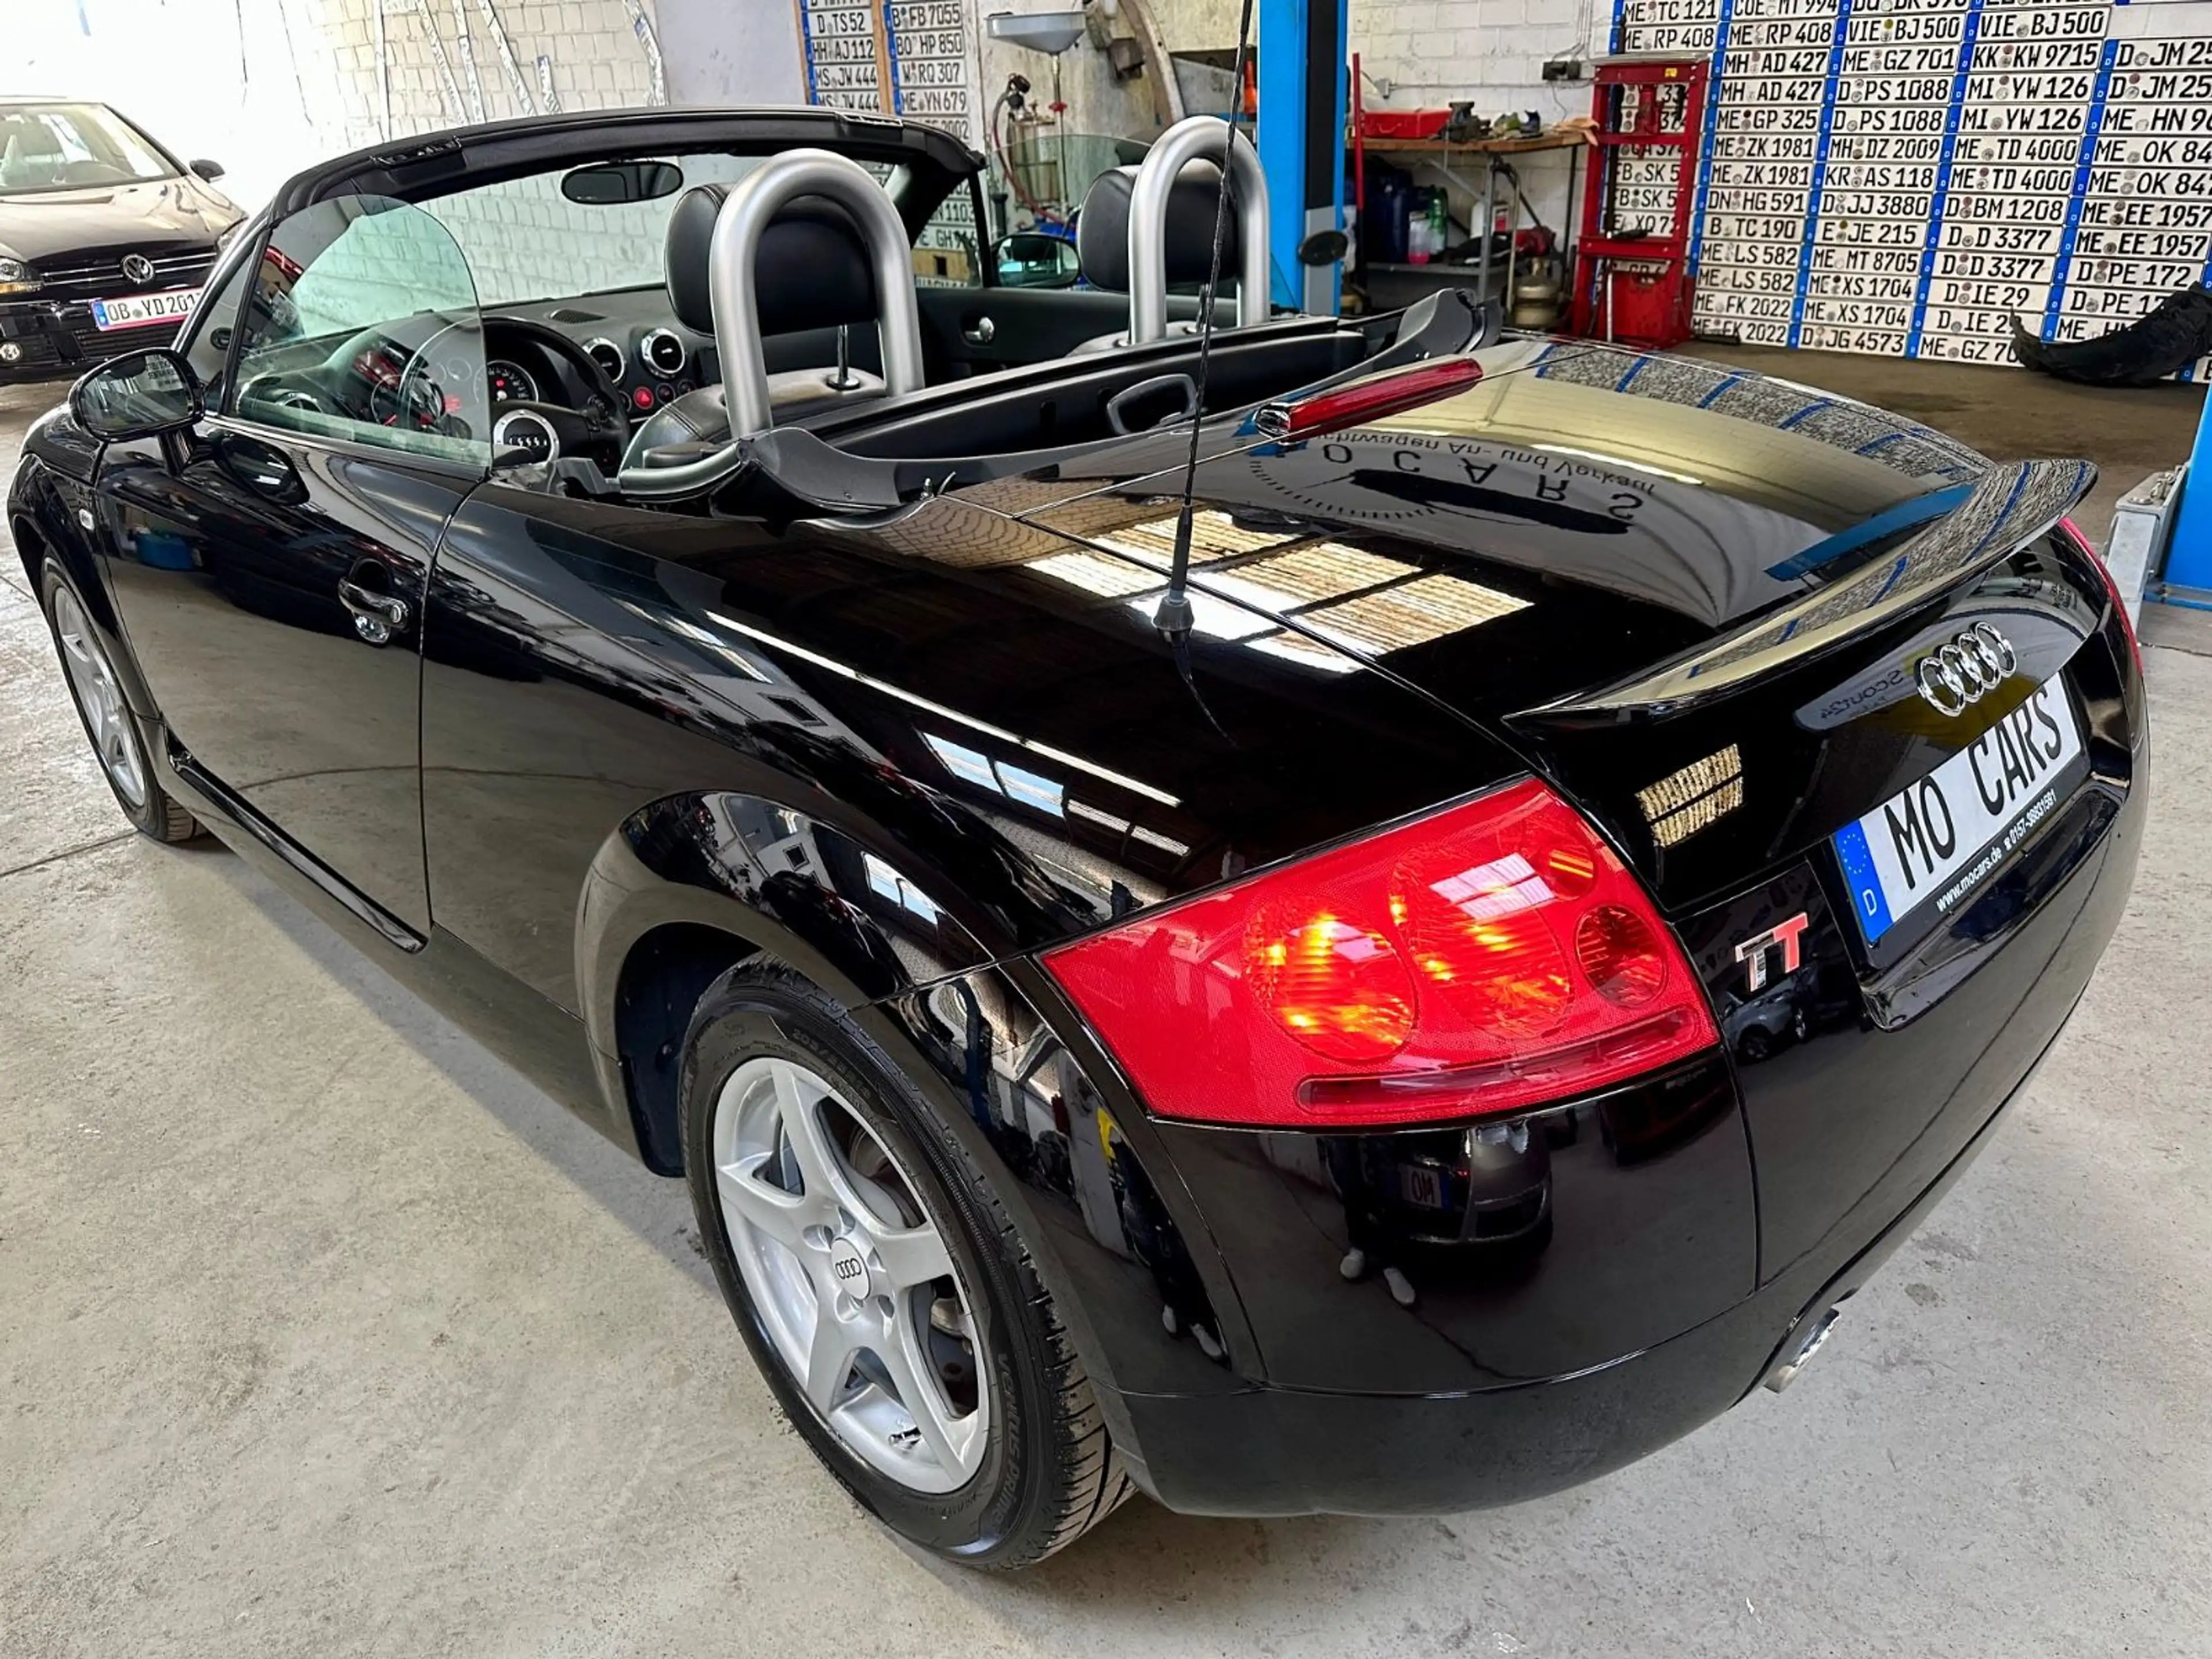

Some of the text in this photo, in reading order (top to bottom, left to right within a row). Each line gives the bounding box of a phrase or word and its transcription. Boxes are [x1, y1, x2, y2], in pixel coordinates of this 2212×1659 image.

[929, 4, 960, 24] 7055
[1659, 2, 1679, 21] TC
[1684, 0, 1715, 19] 121
[817, 12, 865, 33] D TS 52
[1729, 22, 1832, 46] ME RP 408
[1850, 17, 1960, 41] VIE BJ 500
[1981, 11, 2104, 37] VIE BJ 500
[940, 33, 962, 53] 850
[1724, 51, 1827, 74] MH AD 427
[1843, 48, 1954, 71] ME GZ 701
[1973, 43, 2098, 68] KK KW 9715
[938, 63, 960, 82] 307
[1720, 81, 1822, 101] MH AD 427
[1838, 79, 1948, 101] D PS 1088
[1968, 76, 2088, 99] MI YW 126
[2109, 75, 2177, 99] D JM
[944, 92, 966, 112] 679
[1717, 109, 1817, 129] ME GP 325
[1833, 111, 1942, 131] D PS 1088
[1962, 108, 2081, 130] MI YW 126
[1714, 138, 1812, 157] ME ZK 1981
[1830, 138, 1940, 159] MH DZ 2009
[1955, 139, 2077, 161] ME TD 4000
[1711, 165, 1808, 185] ME ZK 1981
[1825, 166, 1933, 188] KR AS 118
[1950, 168, 2071, 191] ME TD 4000
[2088, 171, 2171, 194] ME OK
[1708, 191, 1804, 212] DN HG 591
[1821, 194, 1928, 216] D JJ 3880
[1945, 198, 2063, 221] D BM 1208
[2082, 202, 2110, 224] ME
[2124, 204, 2154, 225] EE
[1710, 217, 1796, 238] B TC 190
[1822, 222, 1917, 244] E JE 215
[1947, 226, 2051, 249] D D 3377
[1700, 244, 1797, 266] ME LS 582
[2076, 232, 2208, 256] ME EE 1957
[1813, 249, 1918, 272] ME MT 8705
[1941, 255, 2045, 279] D D 3377
[1698, 268, 1794, 291] ME LS 582
[2077, 261, 2190, 287] D PE 172
[1695, 294, 1790, 317] ME FK 2022
[1944, 283, 2029, 306] D IE 29
[107, 305, 130, 321] OB
[141, 298, 164, 316] YD
[1805, 302, 1906, 326] ME XS 1704
[1801, 328, 1904, 353] D JG 4573
[1884, 687, 2063, 891] MO CARS
[1936, 846, 2002, 912] www.mocars.de
[1734, 912, 1809, 992] TT
